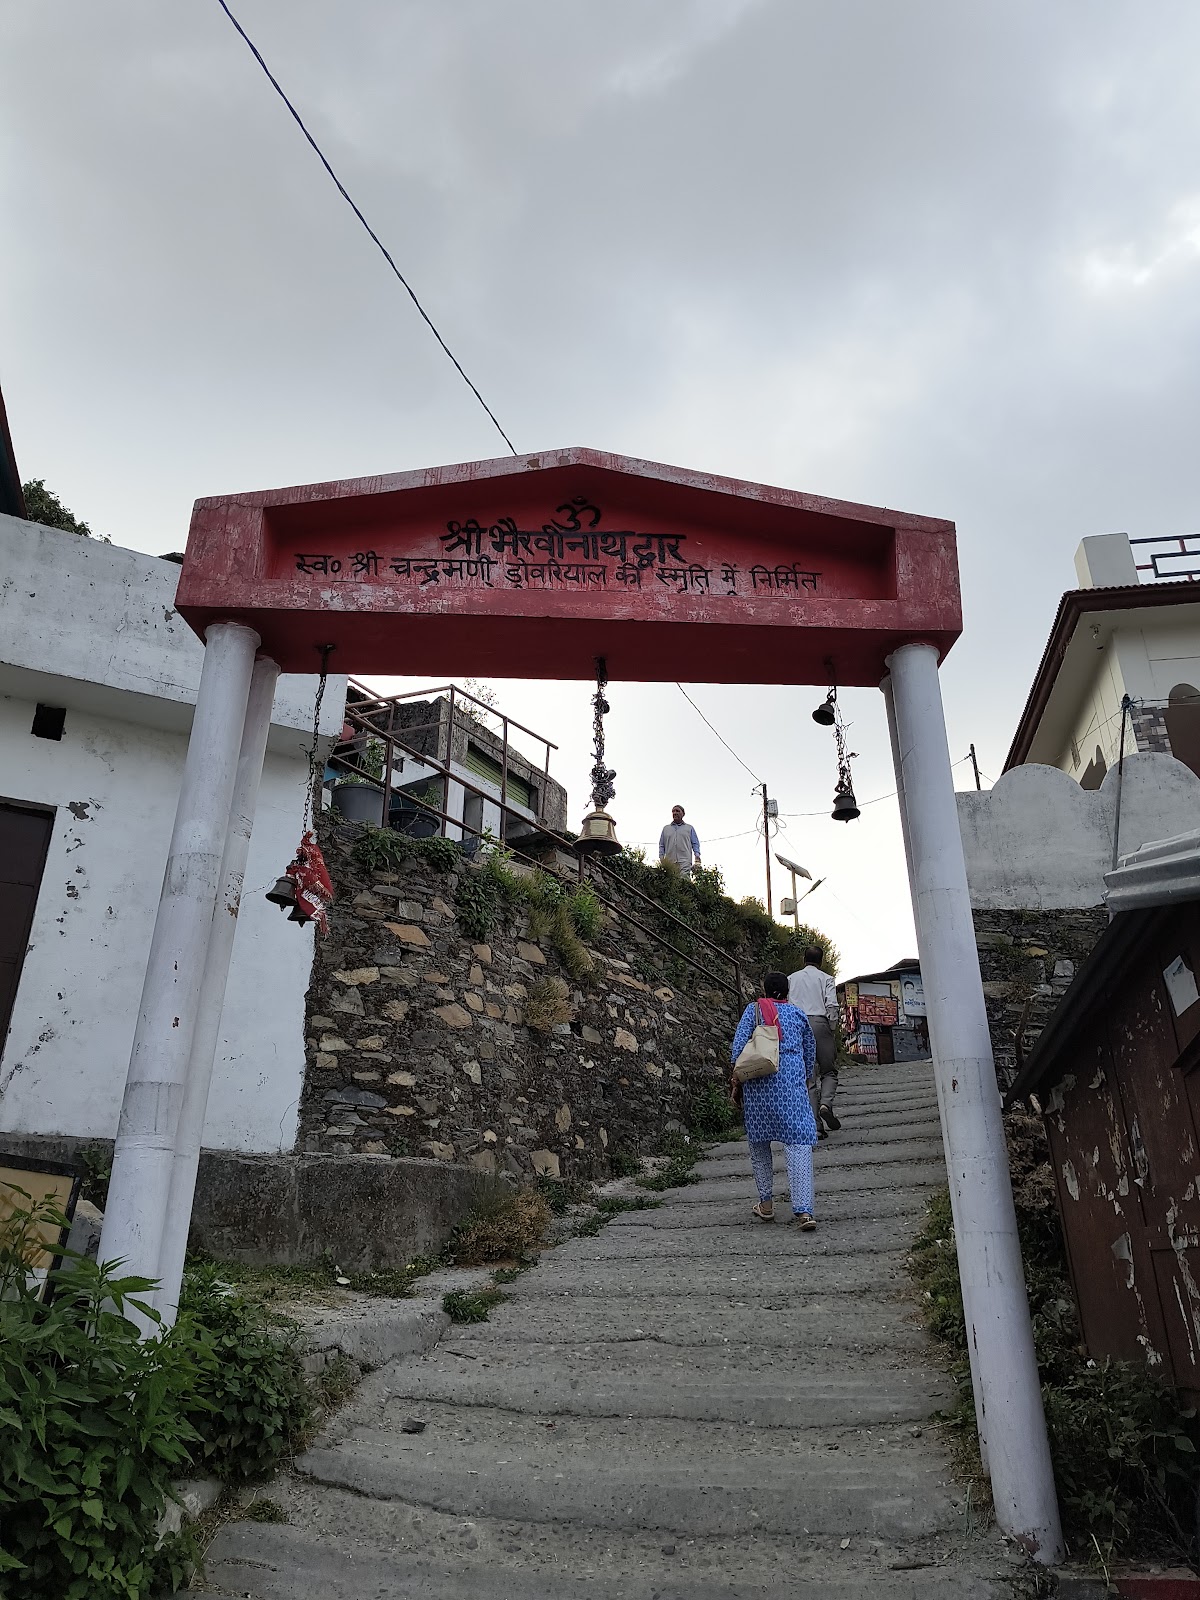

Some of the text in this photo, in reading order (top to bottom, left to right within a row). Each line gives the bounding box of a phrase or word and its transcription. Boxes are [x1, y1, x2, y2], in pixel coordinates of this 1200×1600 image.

[439, 518, 488, 555] श्री
[348, 550, 384, 576] श्री
[615, 562, 641, 589] की
[721, 562, 741, 588] में
[749, 562, 823, 591] निर्मित
